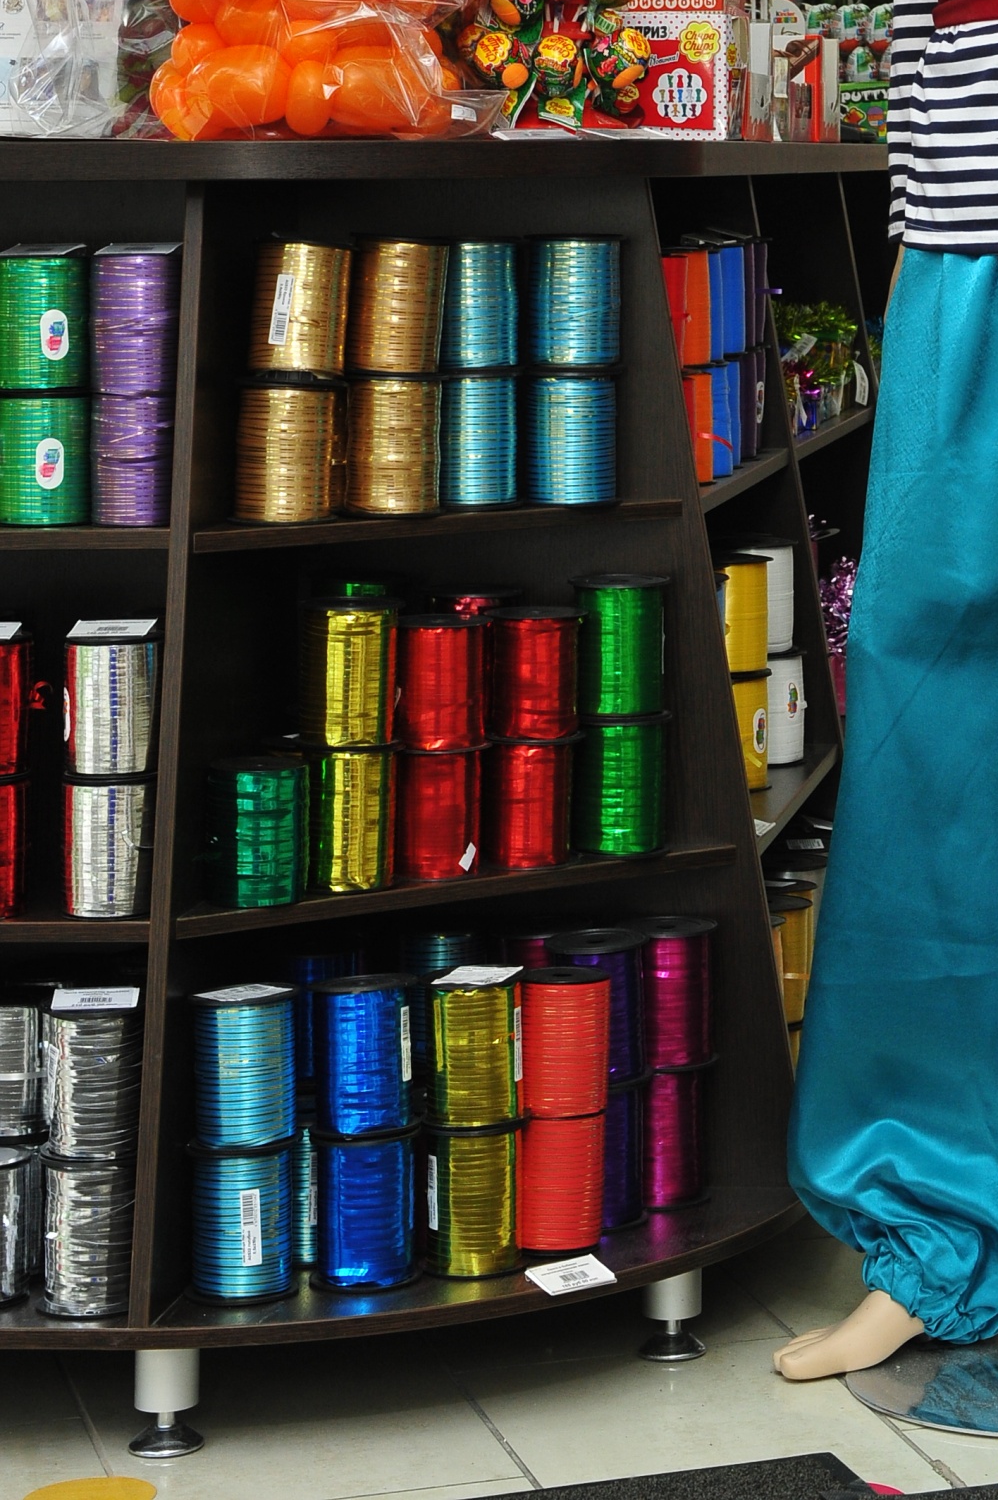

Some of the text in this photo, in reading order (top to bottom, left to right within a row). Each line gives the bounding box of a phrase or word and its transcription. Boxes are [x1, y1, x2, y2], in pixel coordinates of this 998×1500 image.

[684, 30, 716, 41] Chupa
[683, 41, 714, 55] Chups
[841, 88, 888, 102] PUTTY
